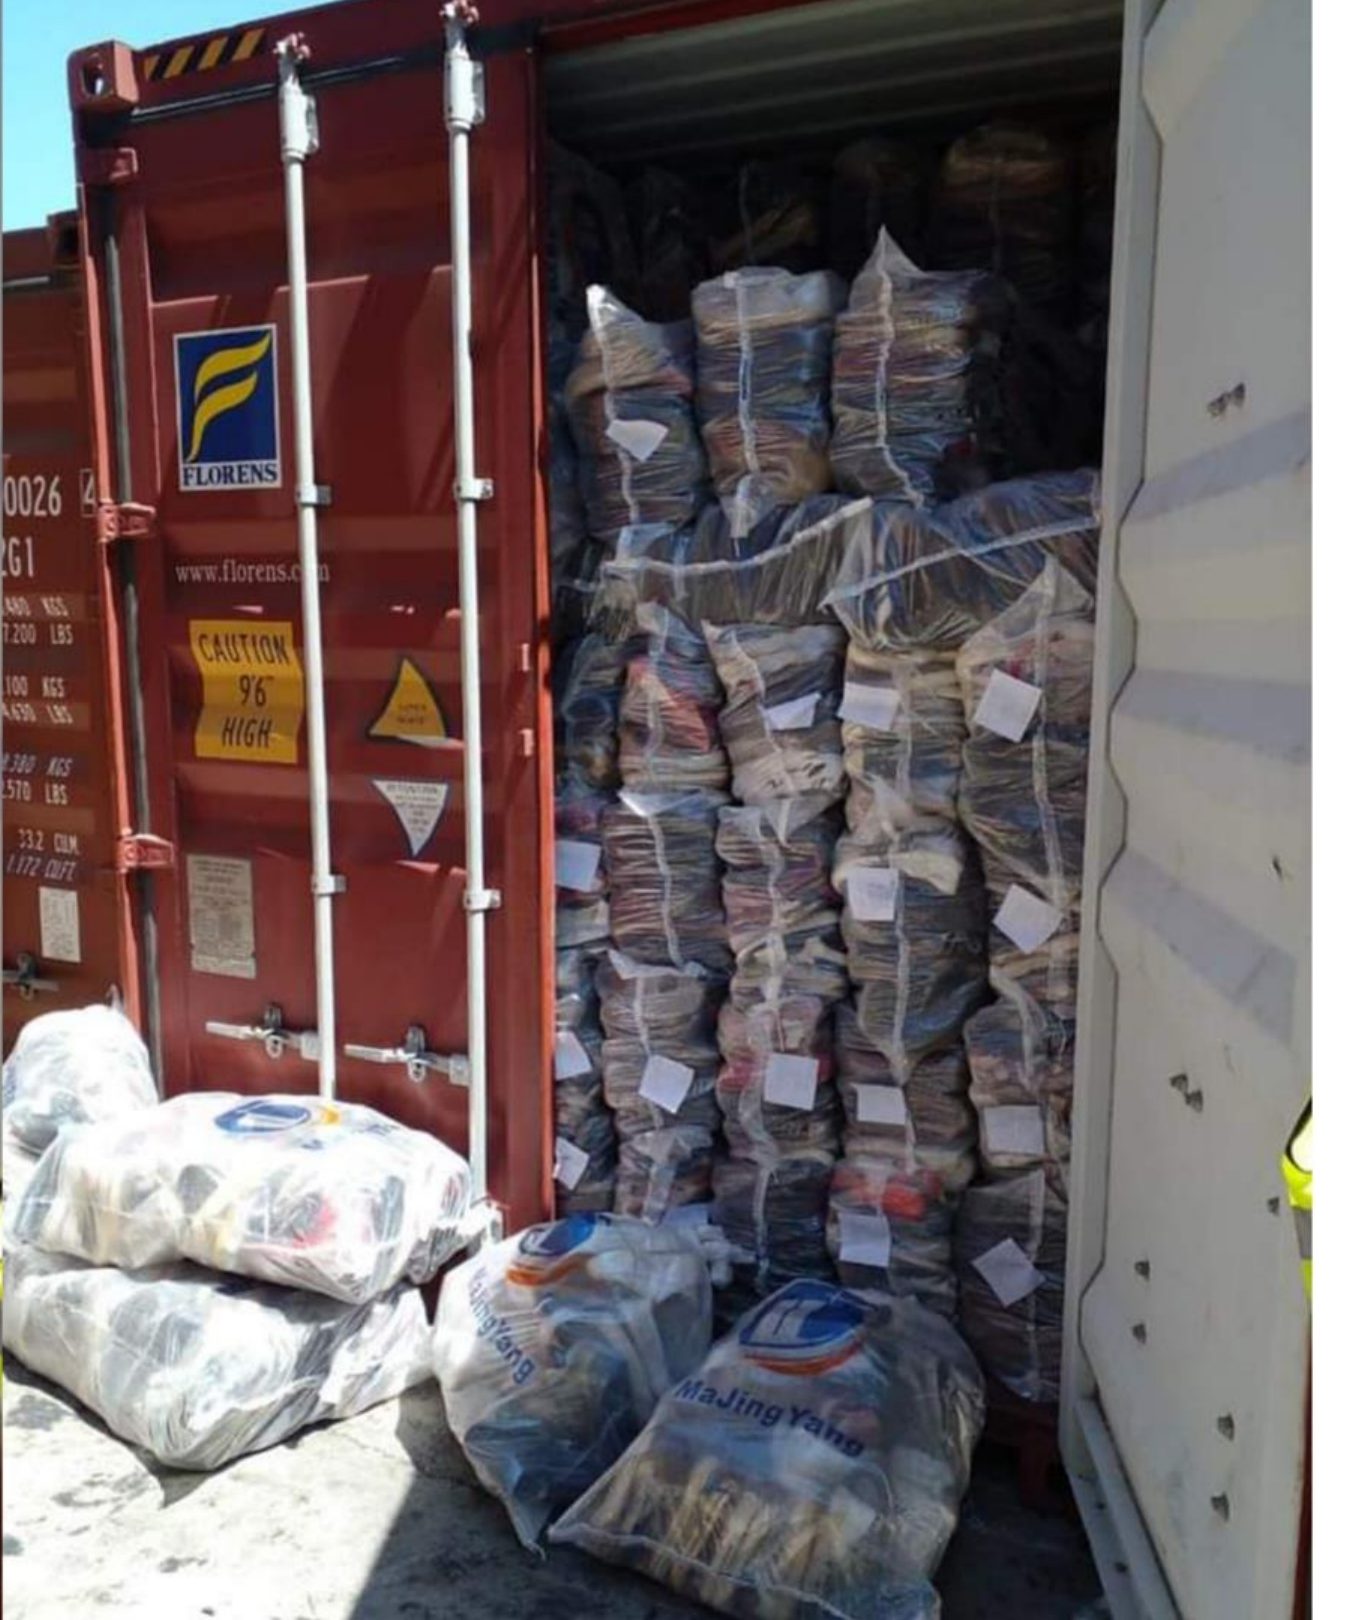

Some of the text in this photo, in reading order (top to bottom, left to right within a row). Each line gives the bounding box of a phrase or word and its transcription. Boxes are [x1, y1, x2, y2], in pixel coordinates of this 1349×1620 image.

[182, 464, 278, 486] FLORENS
[3, 475, 62, 517] 0026
[49, 623, 74, 645] LBS
[199, 633, 290, 665] CAUTION
[41, 676, 65, 698] KGS
[45, 704, 73, 724] LBS
[222, 717, 272, 748] HIGH
[46, 757, 73, 777] KGS
[44, 782, 69, 805] LBS
